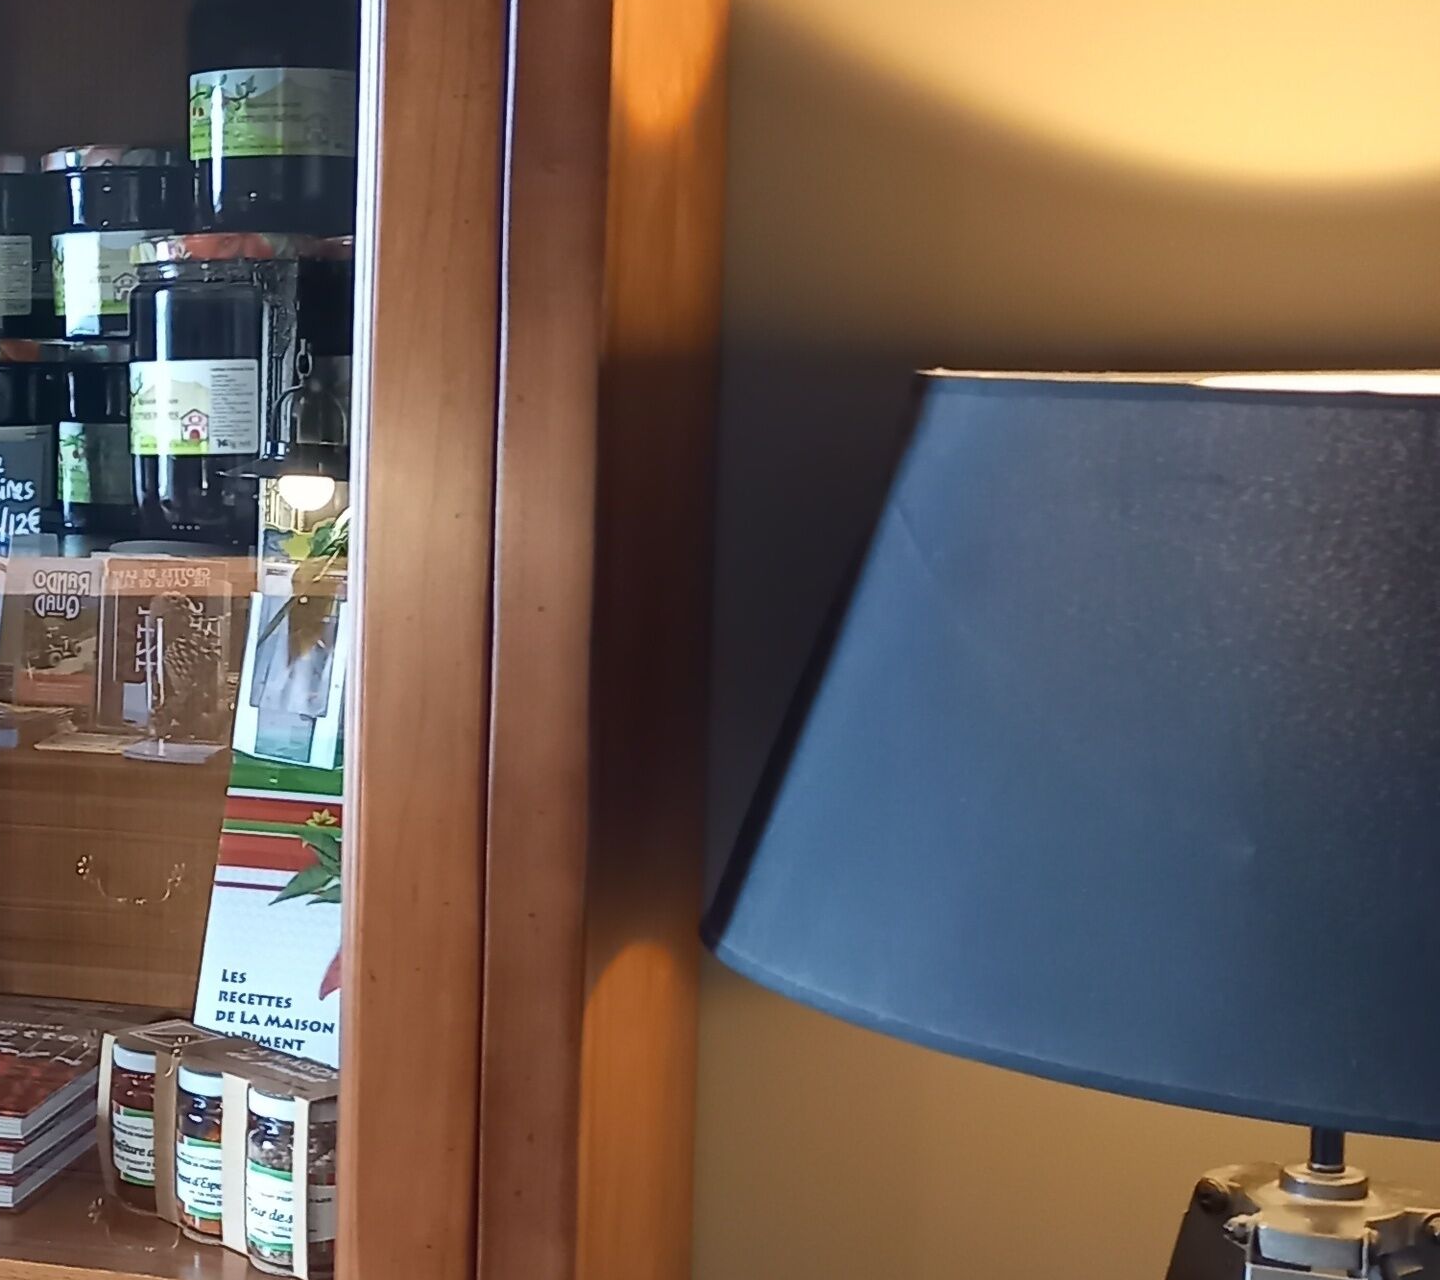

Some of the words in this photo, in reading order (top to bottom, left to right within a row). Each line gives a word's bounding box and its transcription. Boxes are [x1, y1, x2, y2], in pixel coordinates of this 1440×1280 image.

[221, 969, 247, 984] LES
[218, 990, 292, 1009] RECETTES
[215, 1010, 235, 1023] DE
[239, 1011, 260, 1026] LA
[264, 1014, 335, 1034] MAISON
